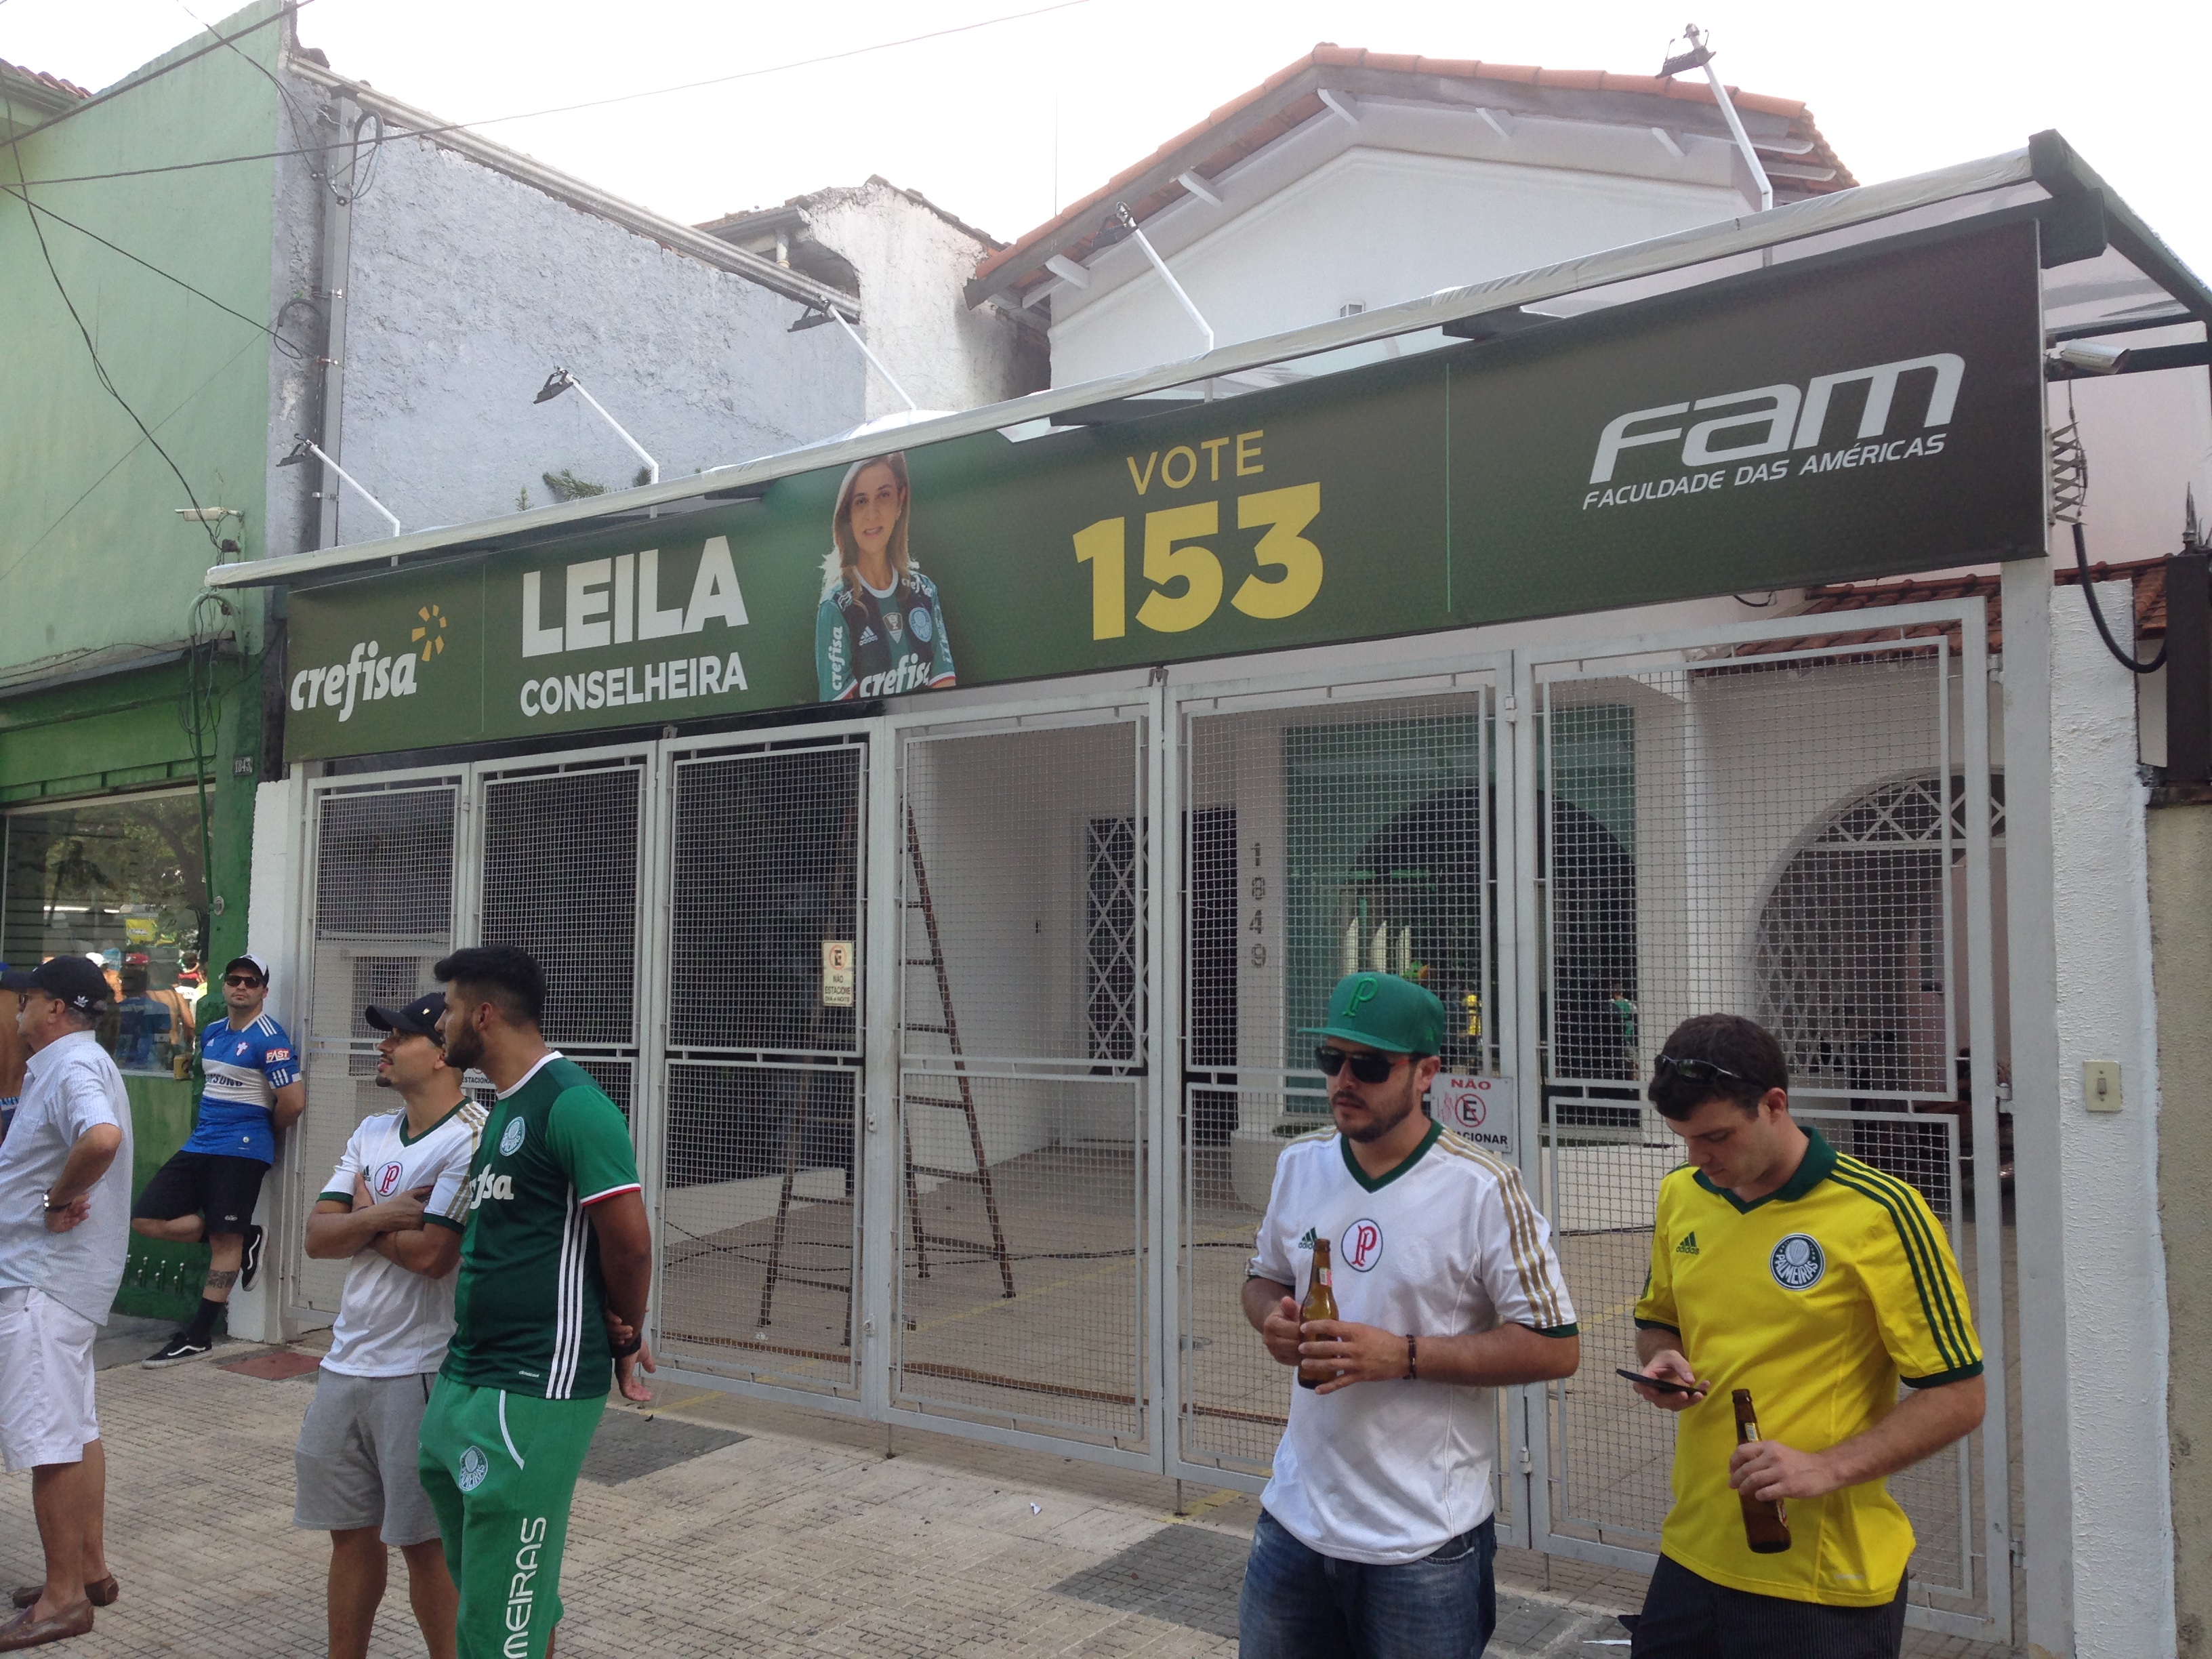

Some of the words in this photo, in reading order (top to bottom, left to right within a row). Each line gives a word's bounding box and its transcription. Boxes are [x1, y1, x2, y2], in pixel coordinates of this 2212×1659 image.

[1126, 429, 1264, 495] VOTE
[1582, 470, 1726, 510] FACULDADE
[1734, 459, 1790, 487] DAS
[1798, 432, 1948, 476] AMÉRICAS
[1072, 481, 1324, 641] 153
[522, 535, 750, 658] LEILA
[290, 640, 417, 722] crefisa
[520, 651, 749, 717] CONSELHEIRA
[828, 626, 846, 691] crefisa
[825, 986, 851, 995] ESTACIONE
[266, 1050, 289, 1061] FAST
[1451, 1078, 1492, 1090] NÃO
[1675, 1245, 1700, 1255] adidas
[1775, 1254, 1818, 1285] PALMEIRAS
